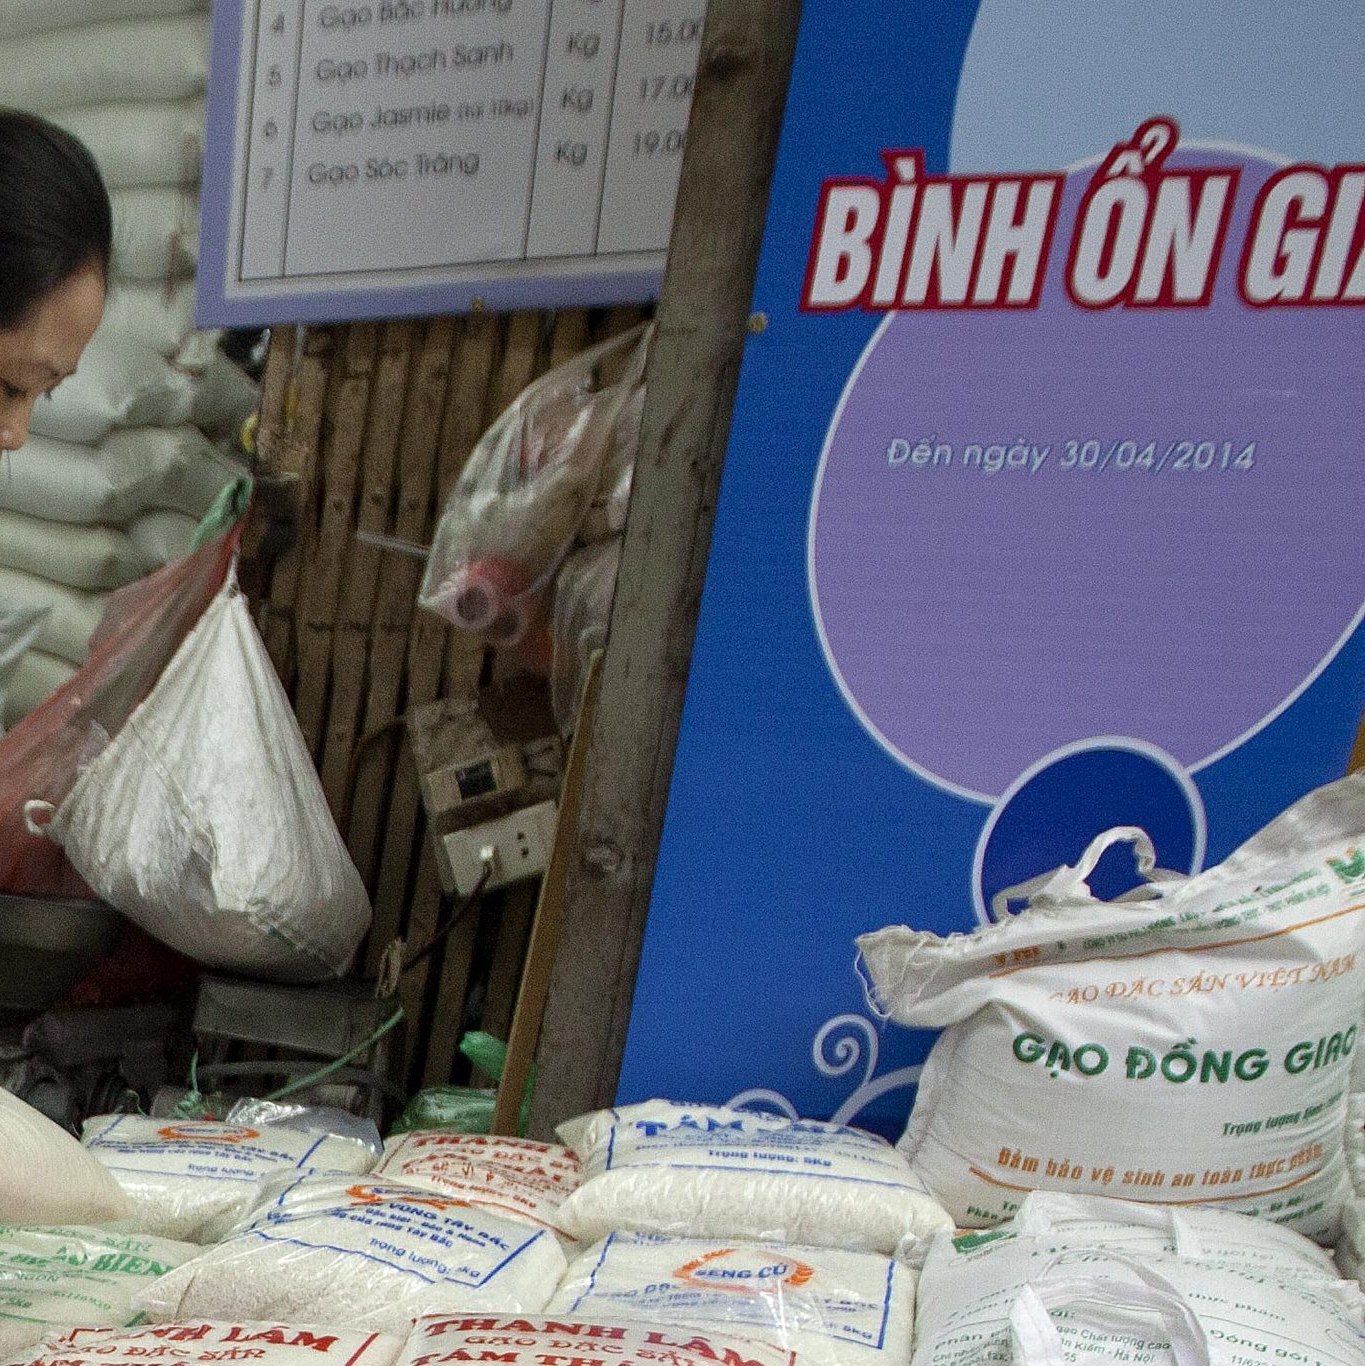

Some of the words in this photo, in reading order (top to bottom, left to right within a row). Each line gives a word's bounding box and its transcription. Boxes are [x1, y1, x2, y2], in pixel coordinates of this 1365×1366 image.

[316, 58, 369, 84] Gạo
[568, 31, 601, 58] Kg
[311, 109, 365, 136] Gạo
[561, 86, 594, 113] Kg
[307, 161, 360, 187] Gạo
[553, 141, 588, 167] Kg
[803, 150, 1064, 311] BÌNH
[1068, 118, 1237, 309] ỔN
[886, 436, 952, 468] Đến
[962, 440, 1051, 474] ngày
[1060, 438, 1257, 473] 30/04/2014
[1012, 1031, 1109, 1081] GẠO
[1125, 1038, 1270, 1084] ĐỒNG
[1282, 1024, 1358, 1076] GIAO
[1045, 1156, 1084, 1181] bảo
[1089, 1164, 1115, 1185] vệ
[1121, 1160, 1165, 1188] sinh
[1170, 1167, 1197, 1188] an
[226, 1325, 341, 1354] LÂM
[423, 1317, 626, 1342] THANH
